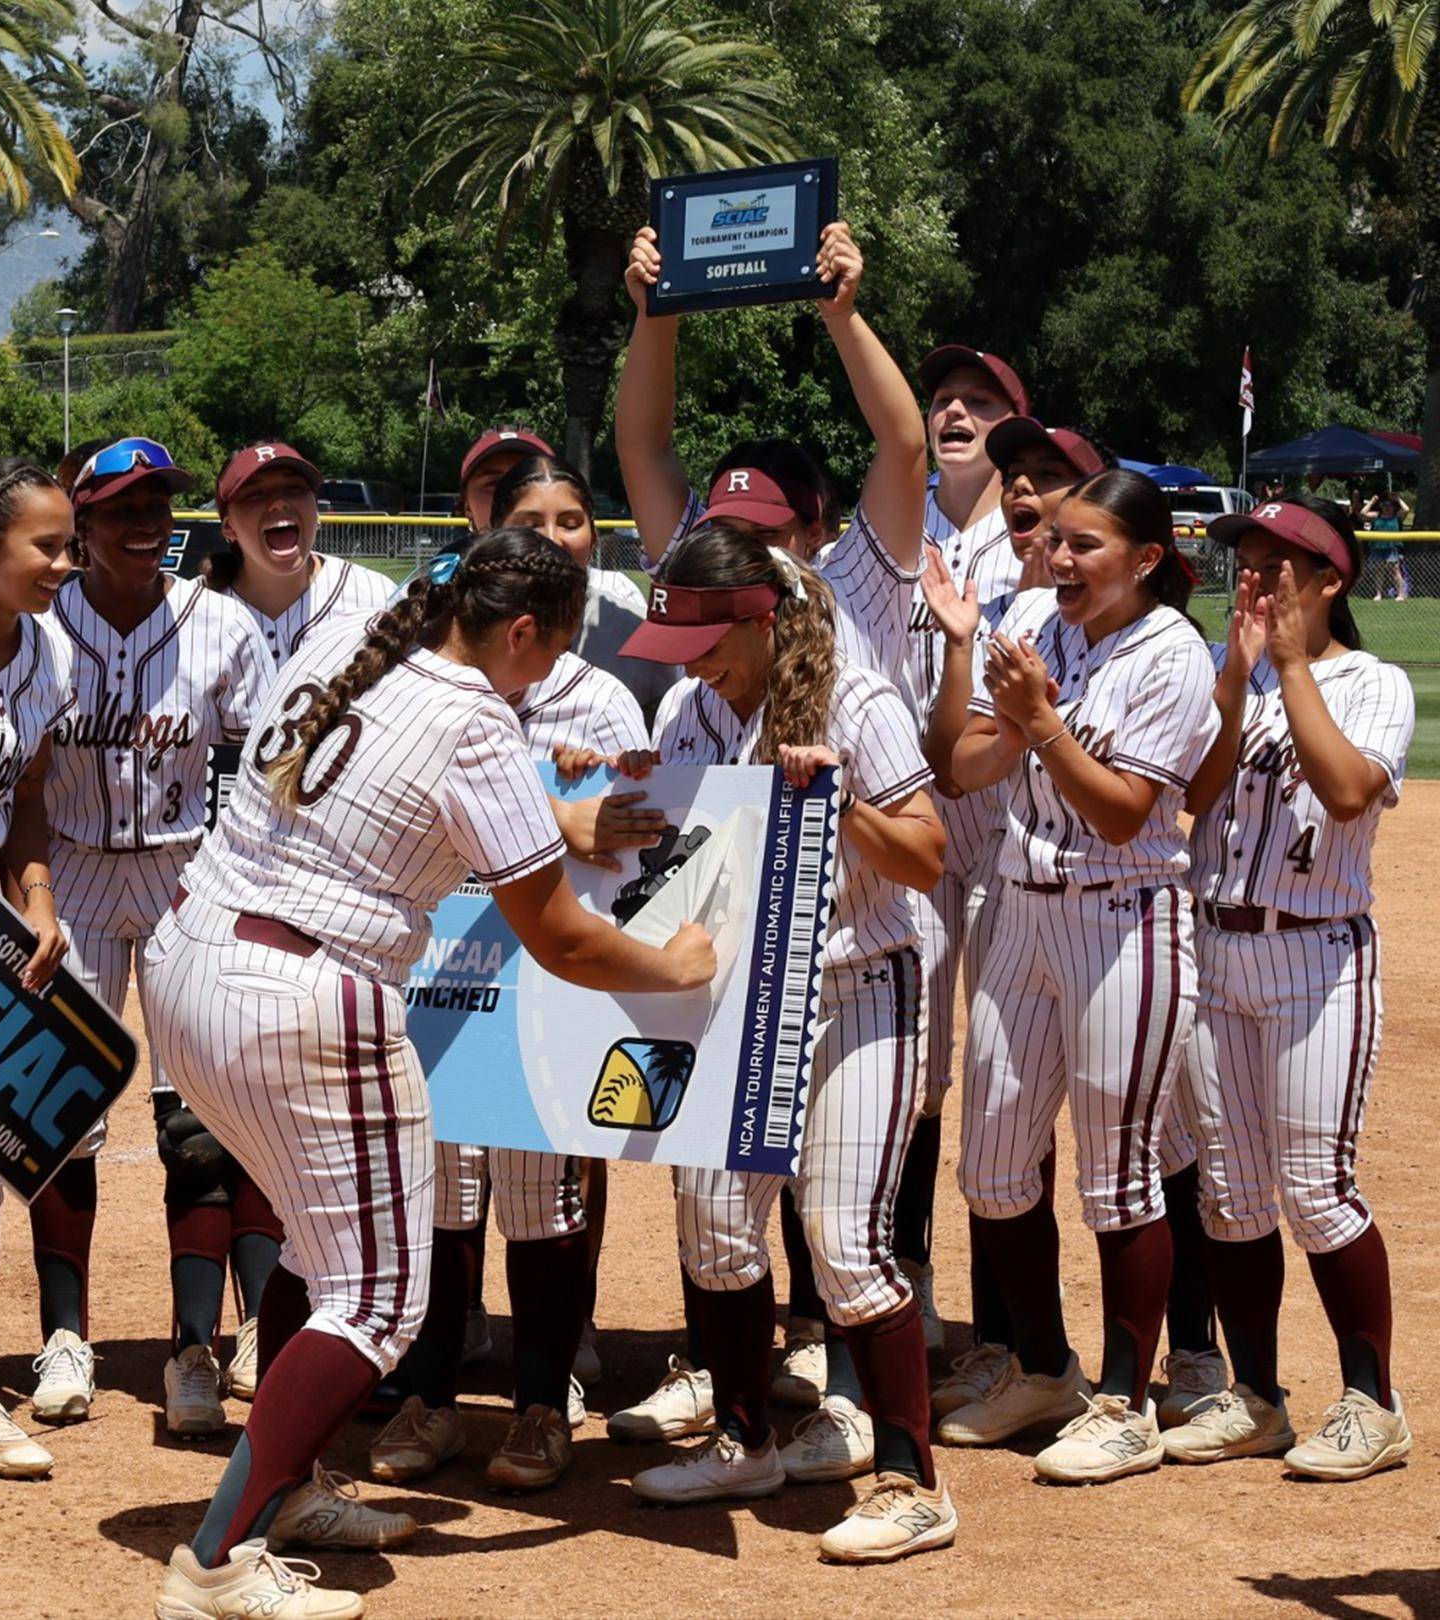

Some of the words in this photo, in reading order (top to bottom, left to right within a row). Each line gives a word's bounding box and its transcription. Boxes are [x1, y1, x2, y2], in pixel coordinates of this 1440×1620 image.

[711, 206, 769, 227] SCIAC
[691, 232, 741, 246] TOURNAMENT
[743, 227, 788, 240] CHAMPIONS
[706, 260, 767, 279] SOFTBALL
[255, 446, 276, 462] R
[727, 471, 750, 492] R
[1256, 504, 1282, 519] R
[651, 588, 668, 614] R
[254, 683, 363, 807] 30
[162, 780, 183, 823] 3
[773, 780, 795, 872] QUALIFIER
[1286, 825, 1316, 874] 4
[761, 875, 785, 976] AUTOMATIC
[422, 937, 503, 976] NCAA
[400, 976, 501, 1013] UNCHED
[745, 979, 774, 1103] TOURNAMENT
[738, 1107, 757, 1156] NCAA
